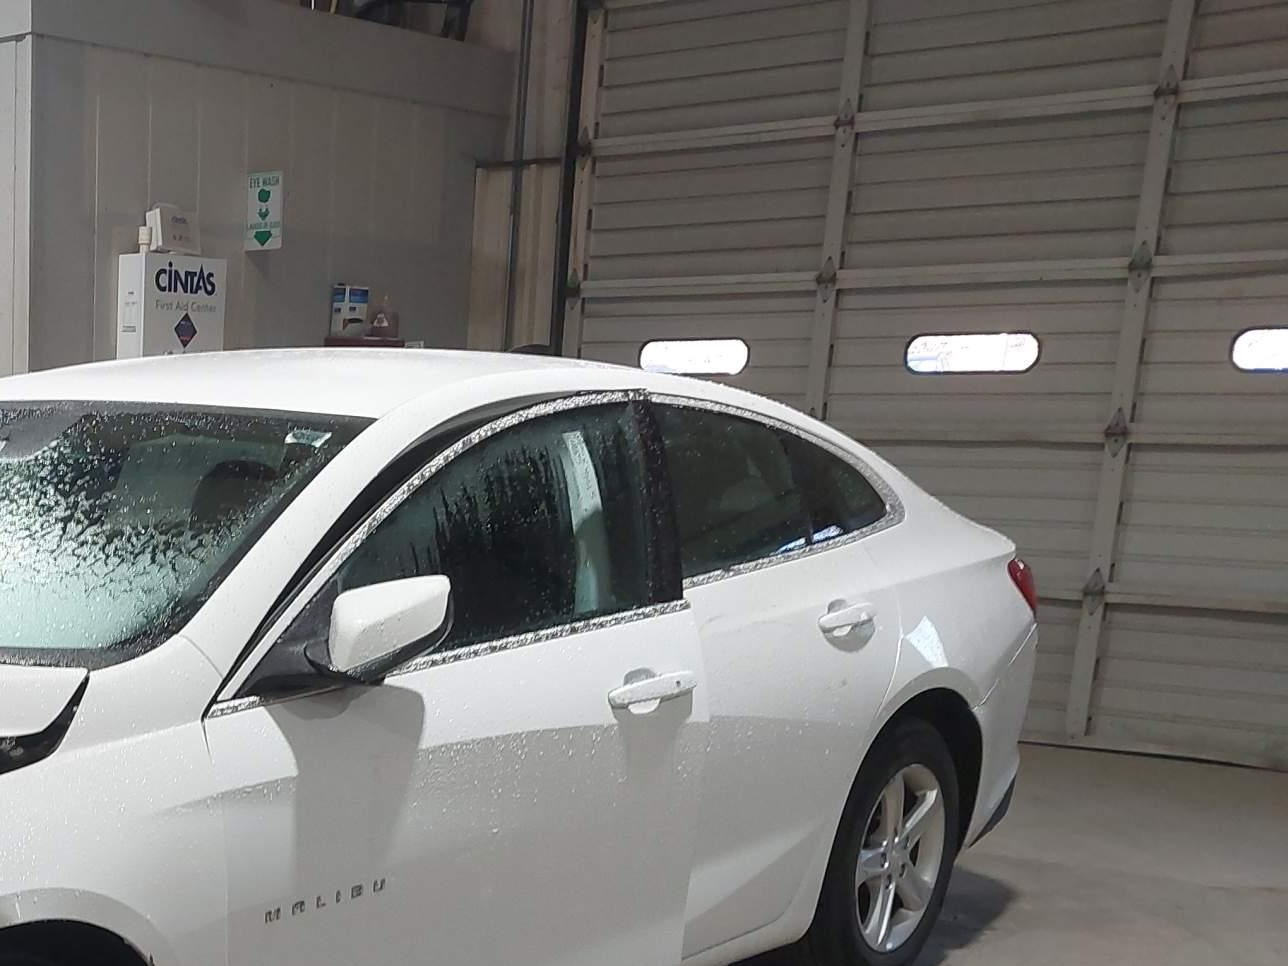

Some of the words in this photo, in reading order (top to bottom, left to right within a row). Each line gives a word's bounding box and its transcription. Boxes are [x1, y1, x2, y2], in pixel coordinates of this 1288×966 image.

[155, 301, 173, 311] First
[176, 301, 189, 312] Aid
[191, 302, 217, 313] Center
[264, 878, 387, 924] MALIBU
